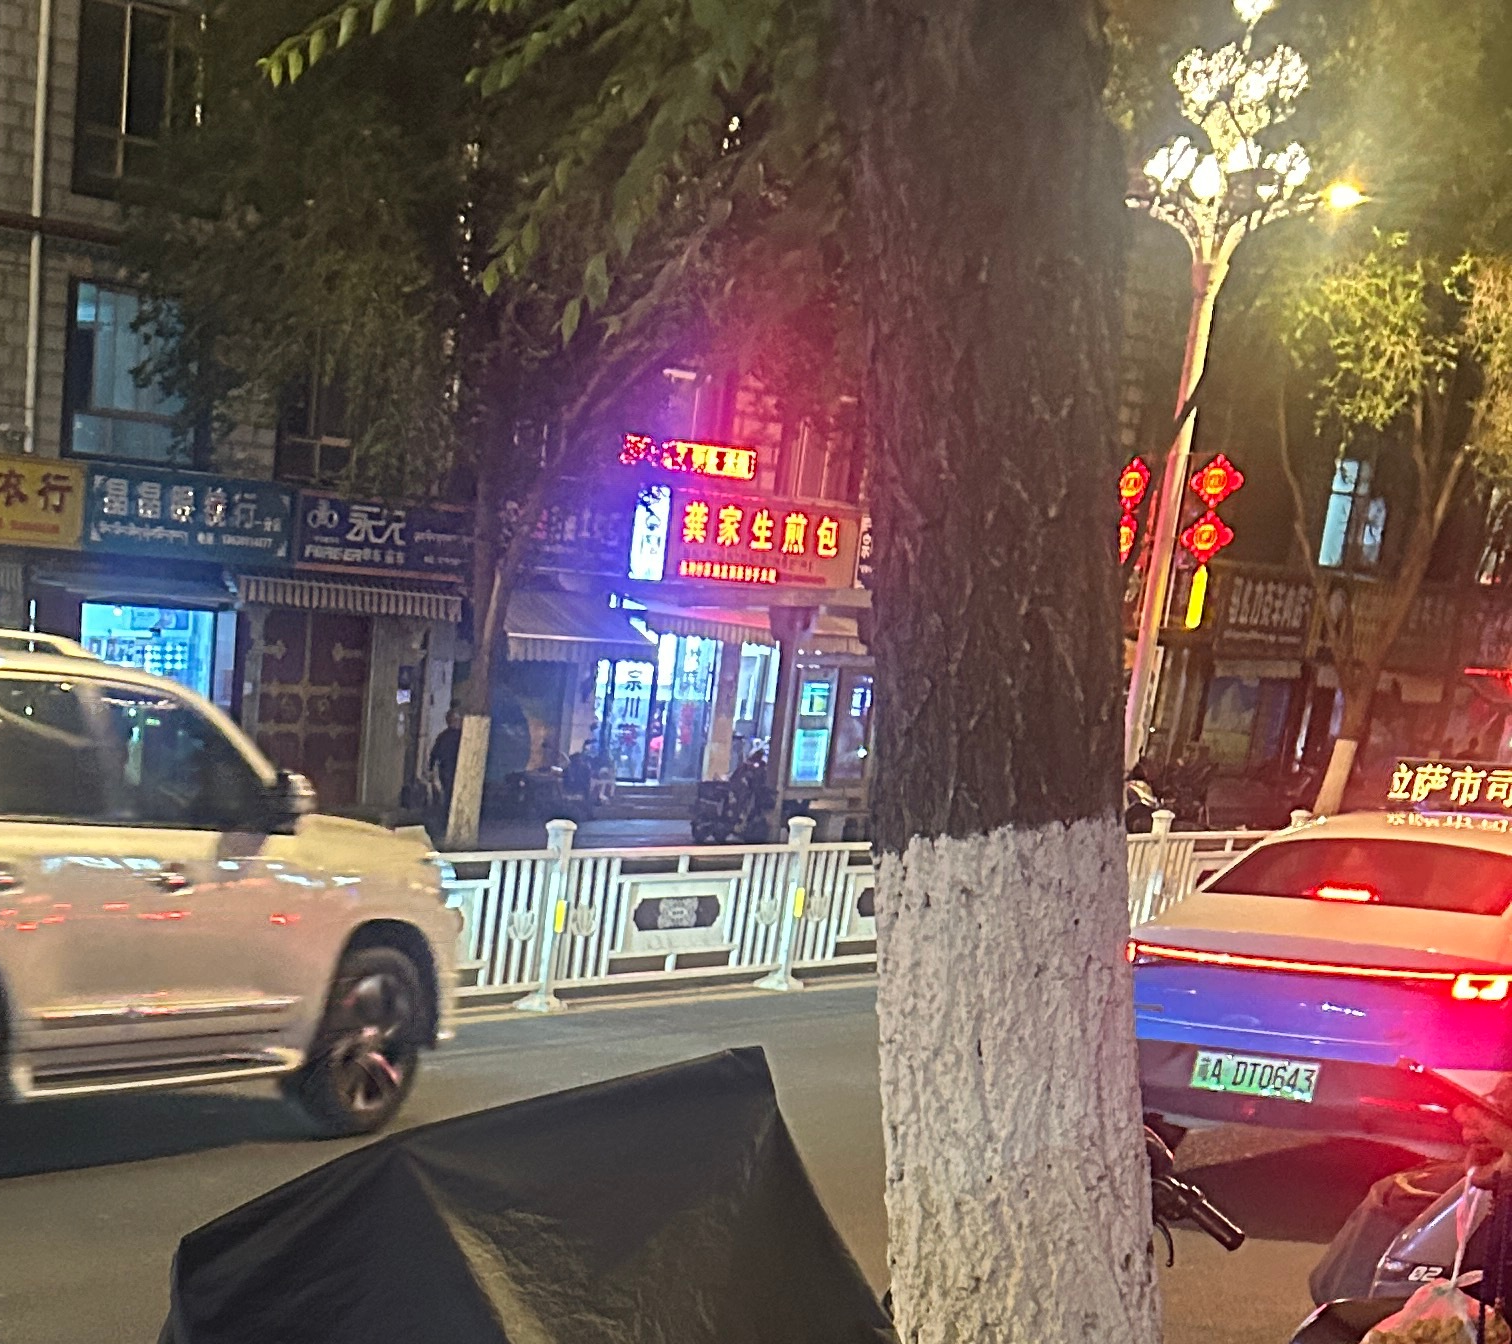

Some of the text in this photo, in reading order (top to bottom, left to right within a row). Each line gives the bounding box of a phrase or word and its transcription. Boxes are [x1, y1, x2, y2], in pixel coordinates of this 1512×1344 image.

[682, 500, 839, 558] 龚家生煎包
